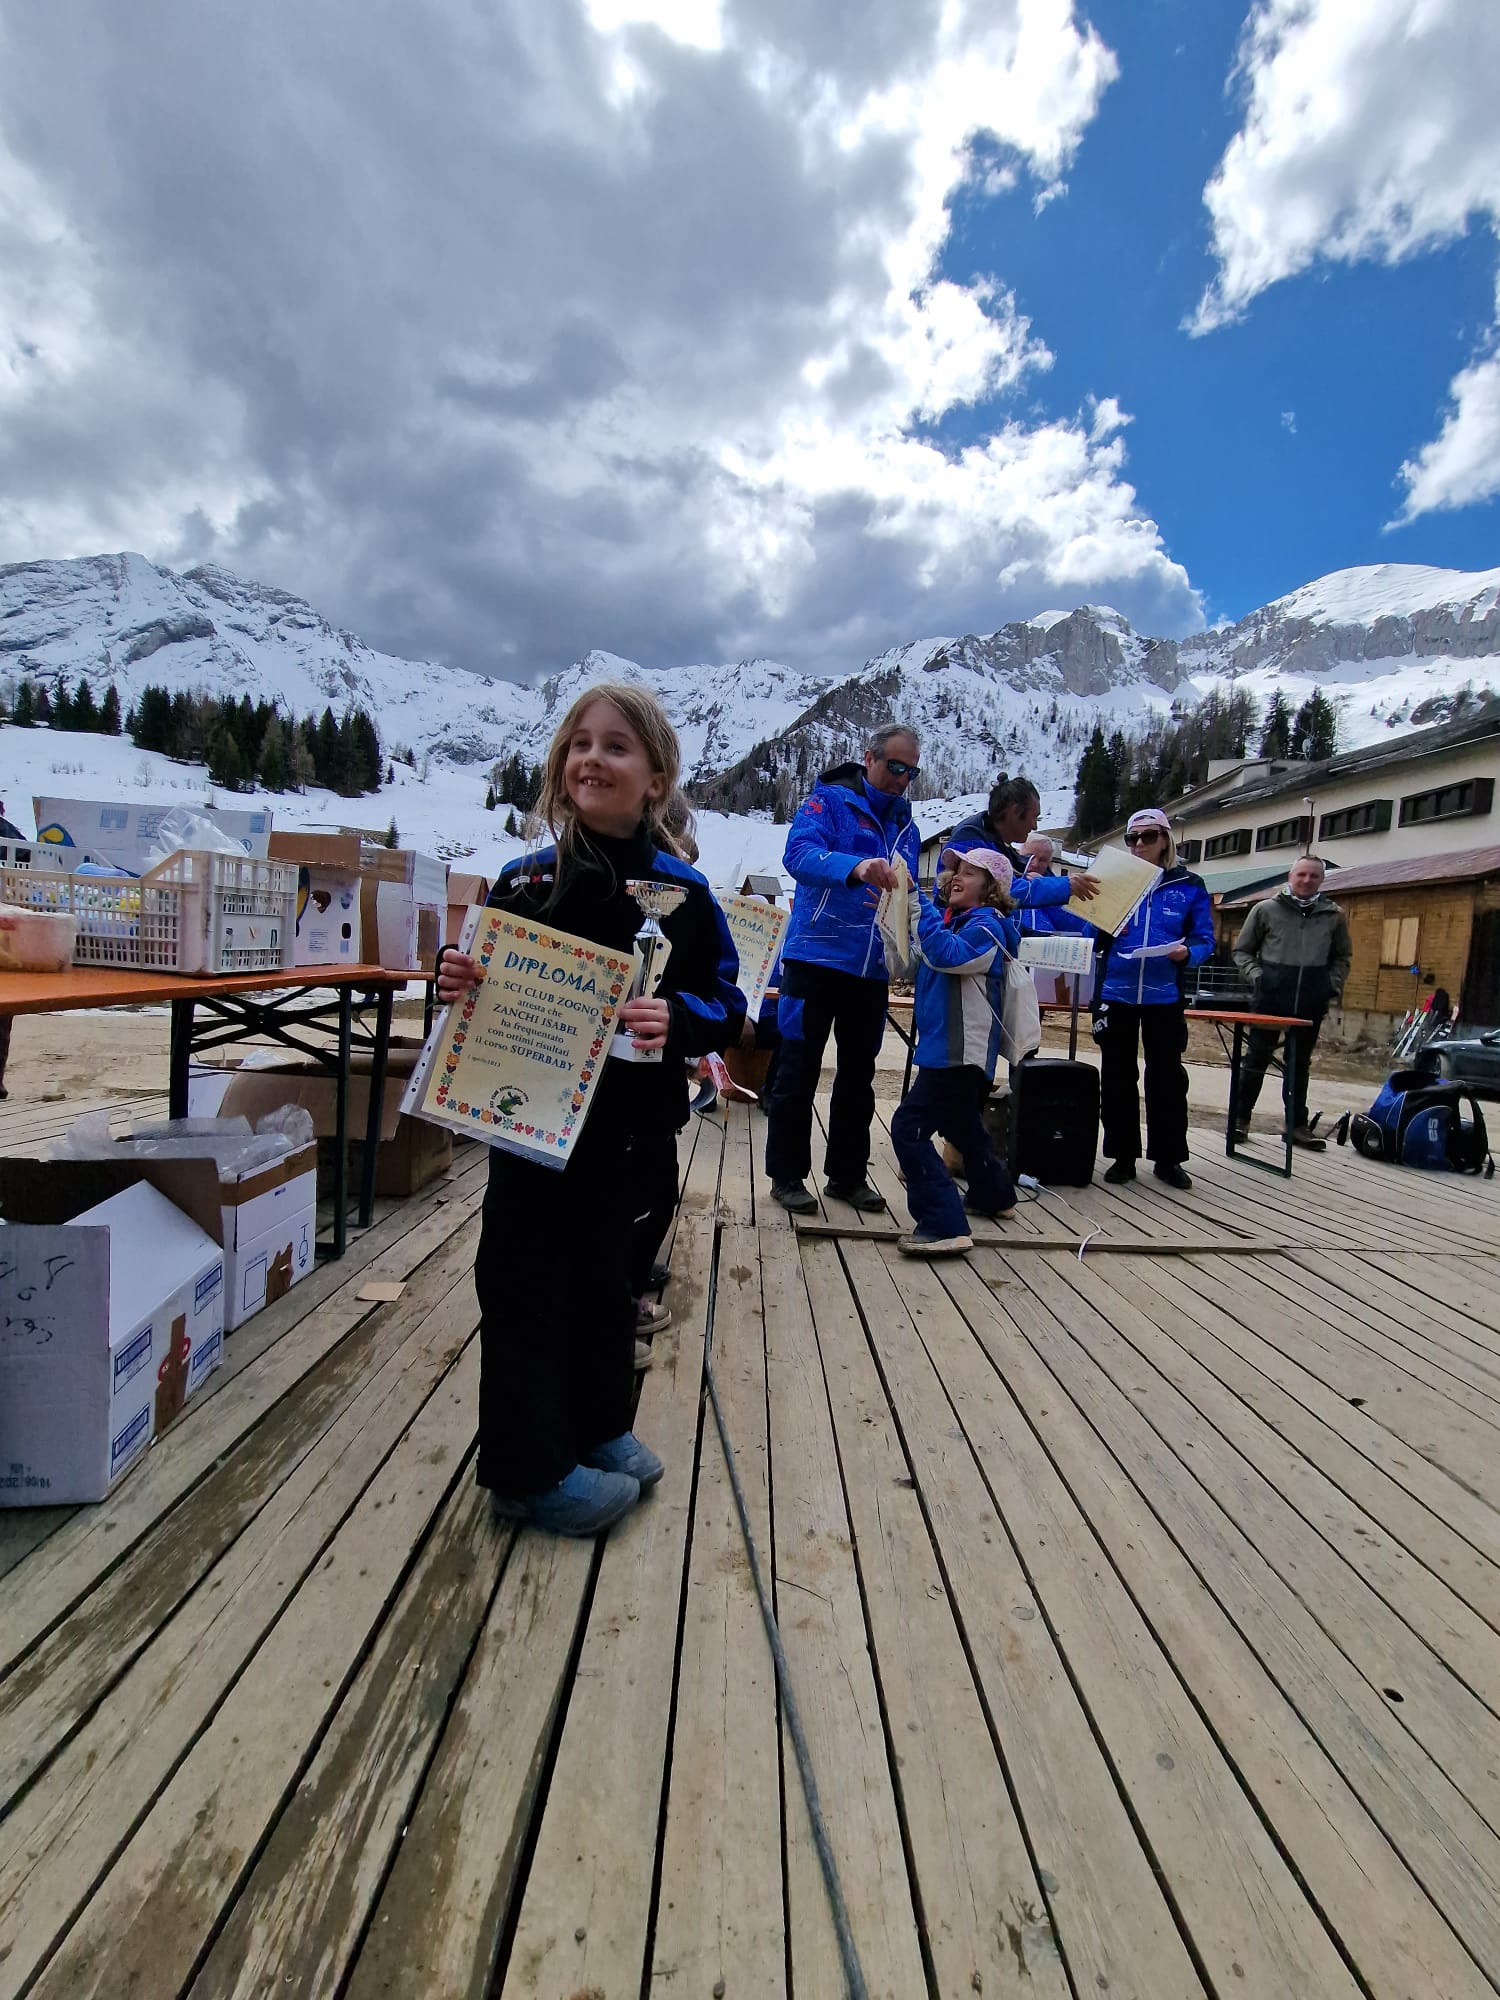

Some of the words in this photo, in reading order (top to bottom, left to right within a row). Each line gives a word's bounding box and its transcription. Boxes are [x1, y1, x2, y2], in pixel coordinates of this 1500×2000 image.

[504, 951, 597, 995] DIPLOMA
[487, 977, 499, 986] Lo
[503, 980, 522, 993] SCI
[524, 987, 555, 1003] CLUB
[556, 996, 599, 1017] ZOGNO
[517, 999, 546, 1013] attesta
[547, 1007, 563, 1018] che
[493, 1003, 539, 1024] ZANCHI
[487, 1027, 504, 1037] con
[506, 1031, 534, 1046] ottimi
[535, 1039, 570, 1057] risultati
[500, 1018, 511, 1028] ha
[513, 1021, 564, 1044] frequentato
[475, 1035, 482, 1043] il
[484, 1039, 508, 1051] corso
[510, 1044, 575, 1071] SUPERBABY
